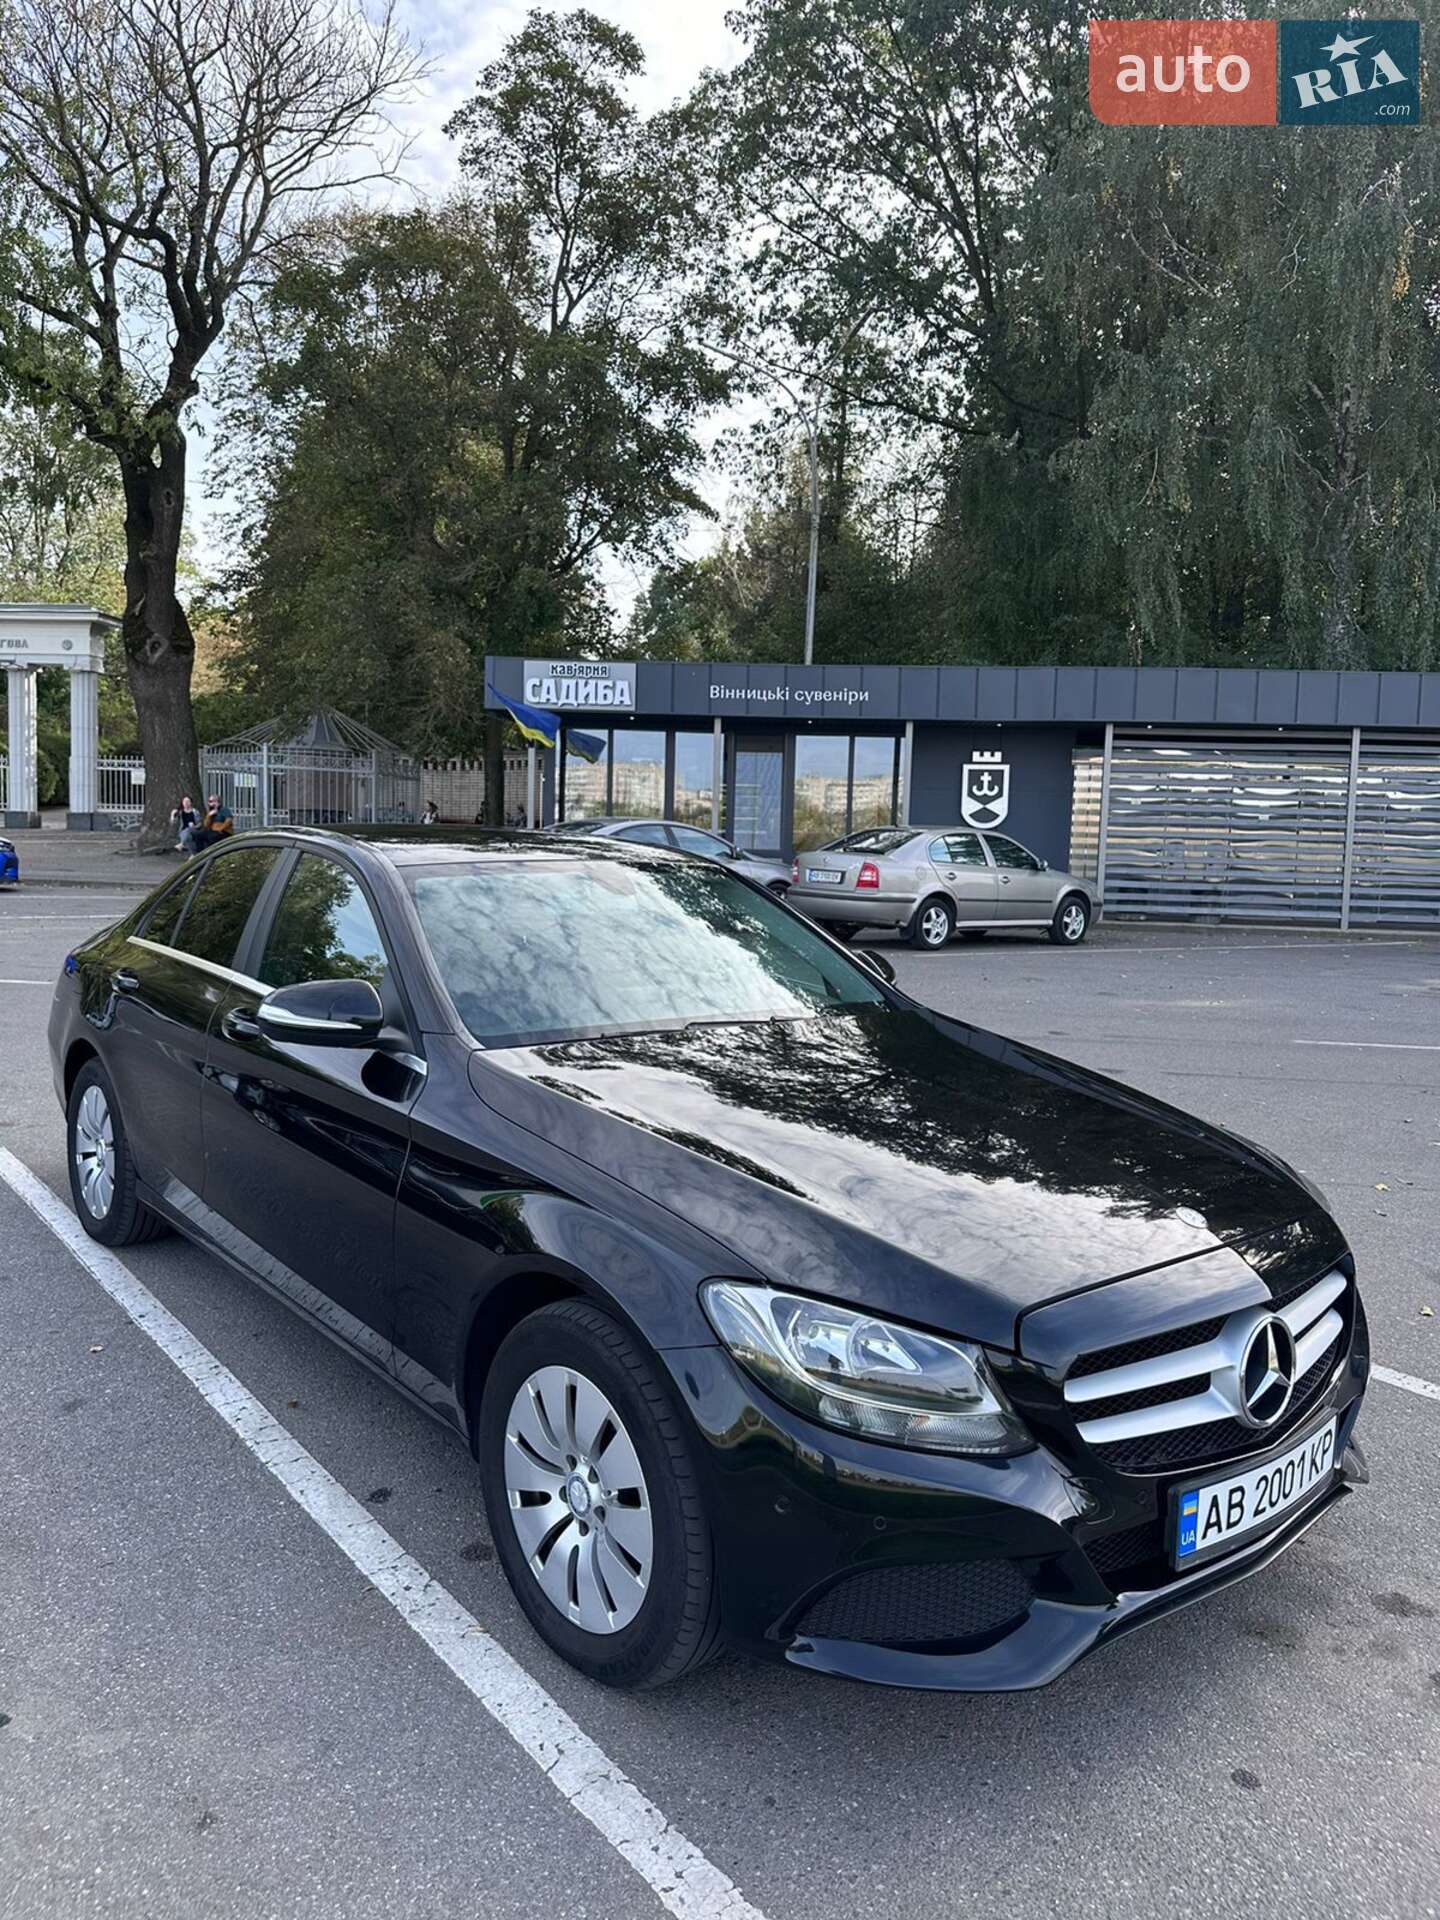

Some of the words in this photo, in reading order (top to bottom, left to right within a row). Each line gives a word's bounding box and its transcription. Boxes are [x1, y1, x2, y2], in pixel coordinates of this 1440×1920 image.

[526, 678, 632, 707] САДИБА
[709, 685, 790, 702] Вінницькі
[794, 688, 869, 705] сувеніри
[1181, 1531, 1196, 1546] UA
